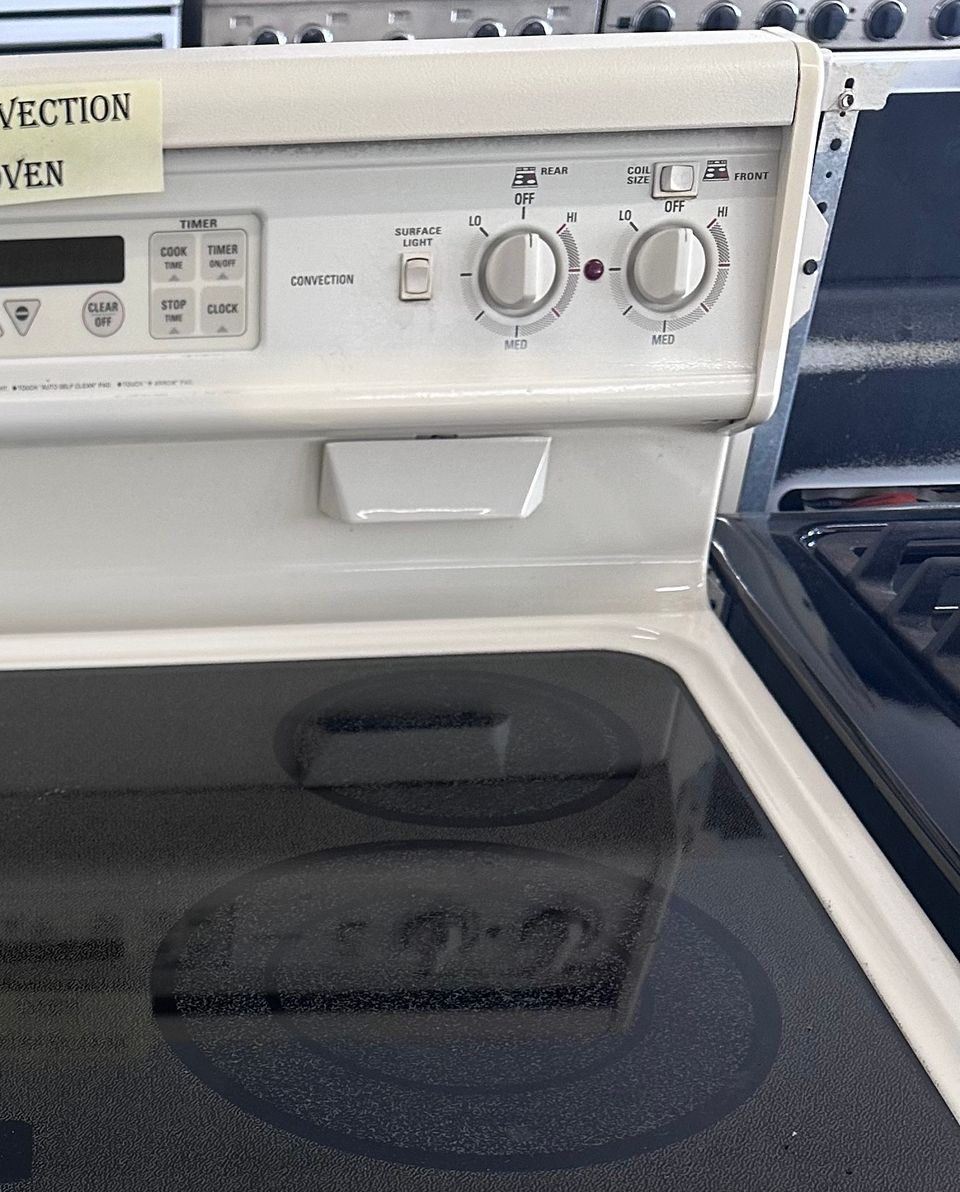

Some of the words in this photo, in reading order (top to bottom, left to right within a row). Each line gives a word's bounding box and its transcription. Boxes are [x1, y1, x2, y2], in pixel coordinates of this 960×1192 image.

[541, 166, 568, 176] REAR
[627, 166, 651, 175] COIL
[734, 170, 769, 181] FRONT
[627, 175, 650, 185] SIZE
[514, 193, 535, 206] OFF
[664, 200, 685, 214] OFF
[717, 206, 728, 218] HI
[469, 215, 482, 227] LO
[566, 211, 578, 224] HI
[618, 209, 632, 221] LO
[179, 218, 218, 230] TIMER
[394, 226, 442, 237] SURFACE
[402, 238, 433, 248] LIGHT
[160, 246, 187, 257] COOK
[207, 244, 239, 256] TIMER
[164, 260, 183, 270] TIME
[290, 274, 355, 288] CONVECTION
[87, 301, 119, 314] CLEAR
[161, 299, 187, 311] STOP
[206, 303, 239, 315] CLOCK
[94, 316, 112, 328] OFF
[504, 339, 528, 350] MED
[652, 334, 676, 345] MED
